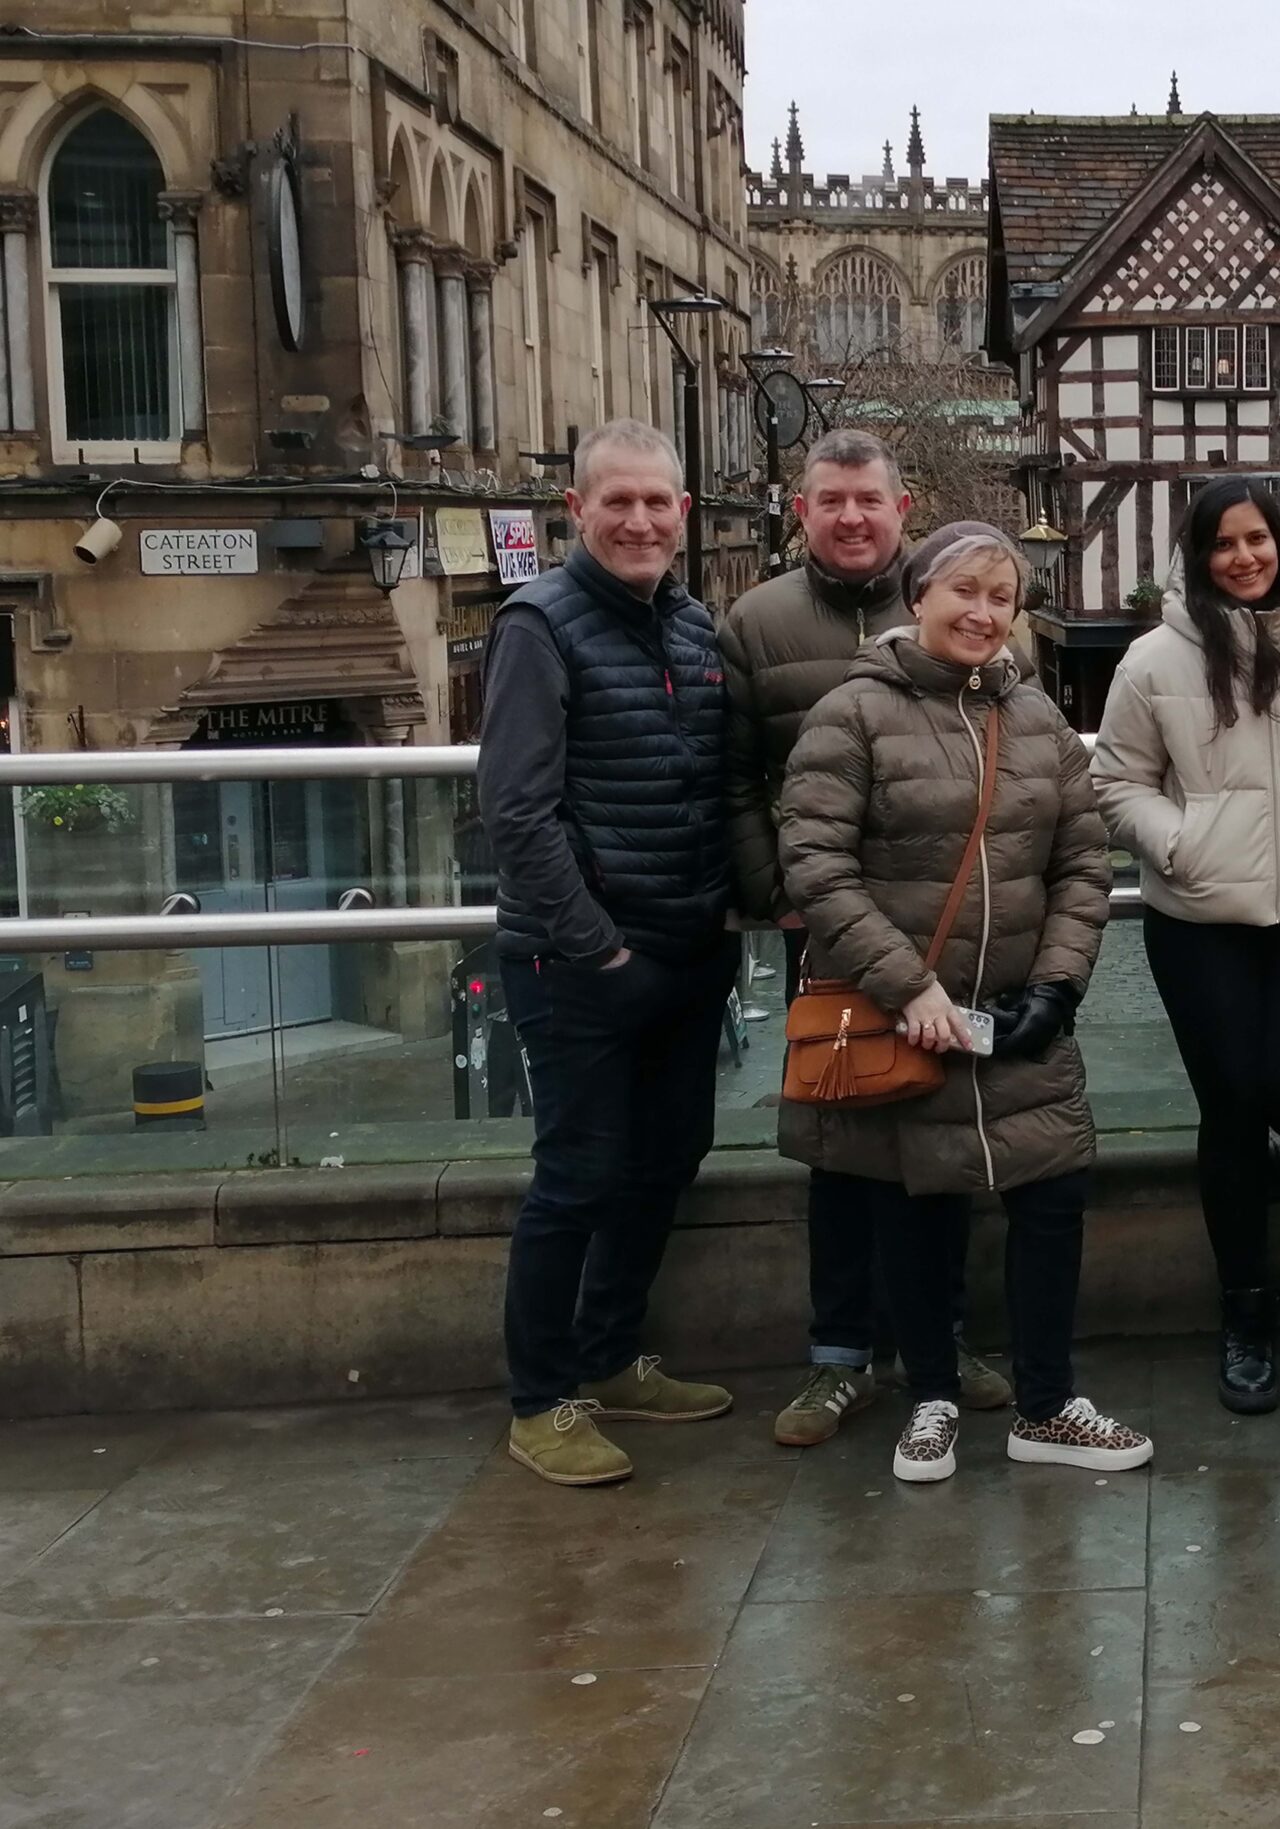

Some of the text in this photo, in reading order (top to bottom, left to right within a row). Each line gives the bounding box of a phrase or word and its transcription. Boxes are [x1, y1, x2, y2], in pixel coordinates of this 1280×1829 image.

[144, 534, 252, 550] CATEATON
[162, 554, 236, 569] STREET
[207, 704, 328, 730] THE MITRE
